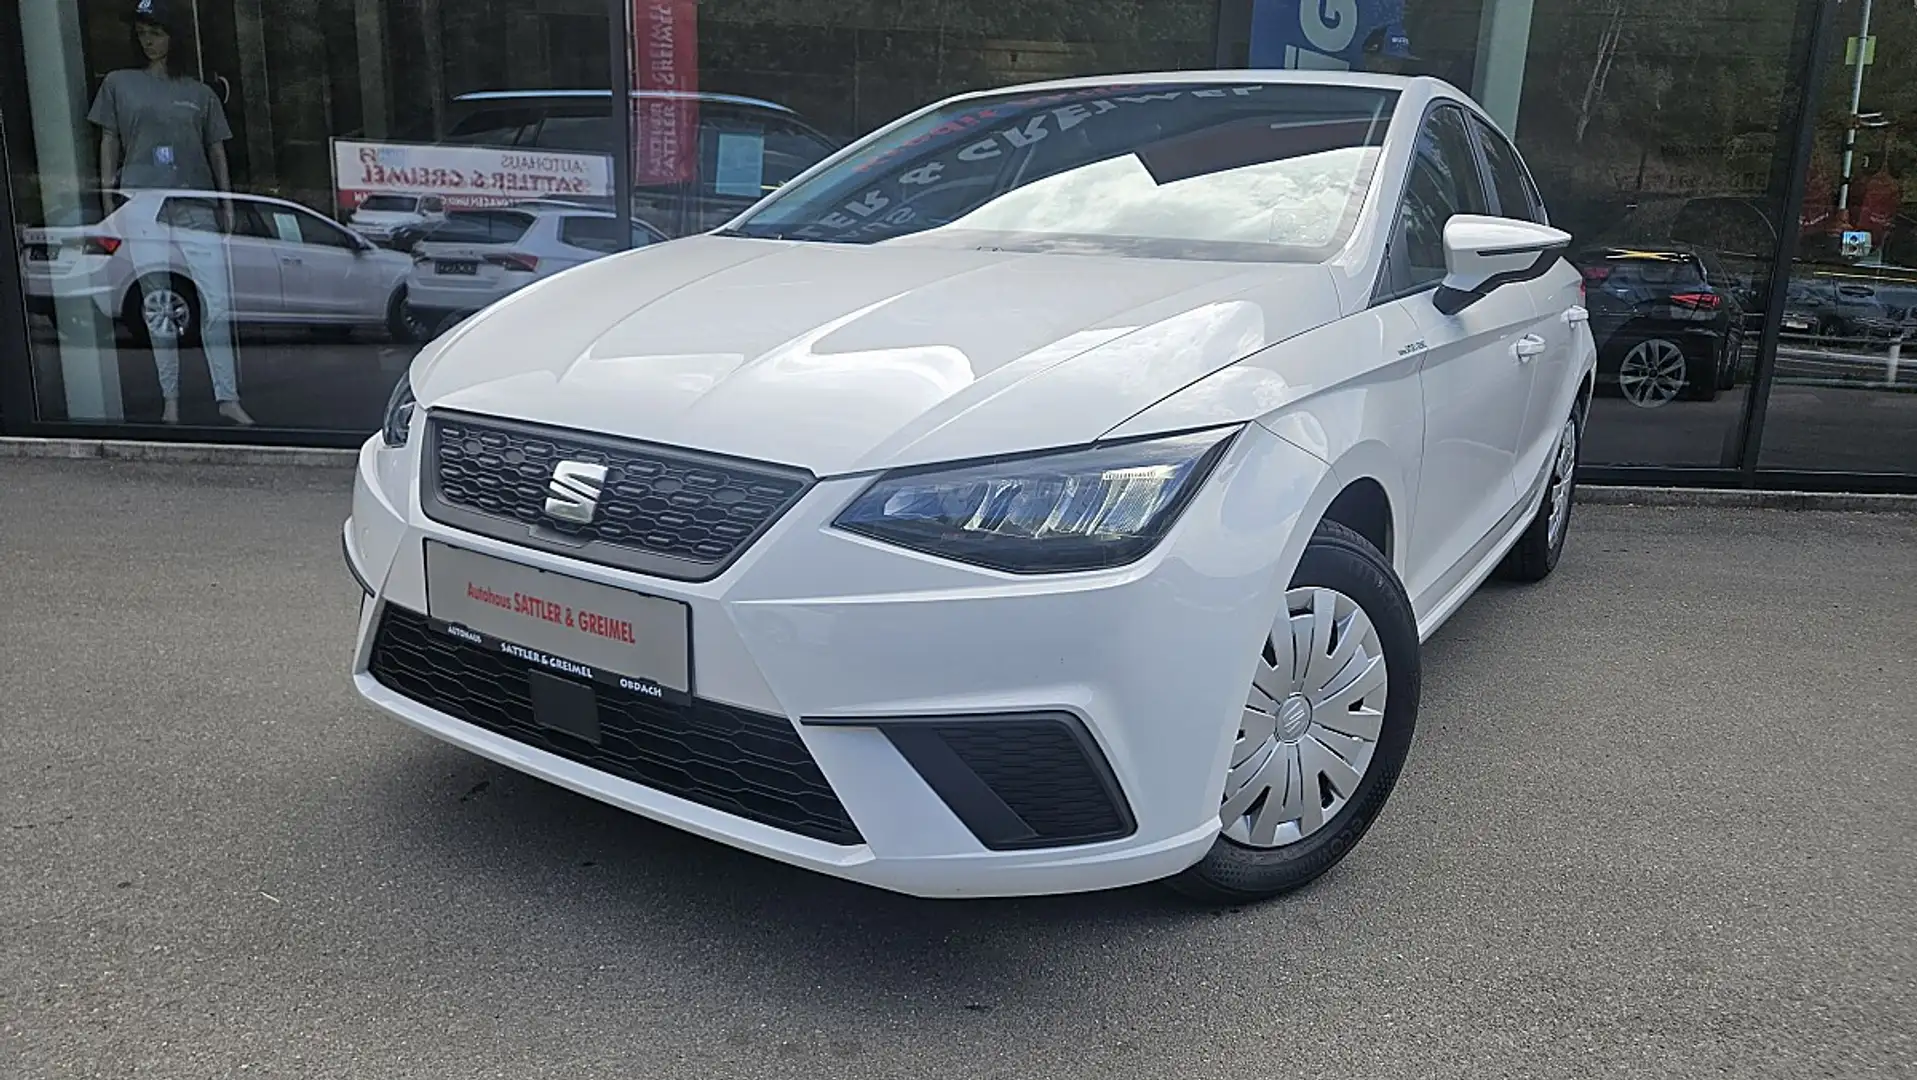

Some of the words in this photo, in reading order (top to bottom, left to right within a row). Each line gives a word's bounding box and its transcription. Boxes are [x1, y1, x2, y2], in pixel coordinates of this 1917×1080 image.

[467, 581, 512, 611] Autohaus
[513, 591, 562, 625] SATTLER
[565, 608, 574, 627] &
[578, 611, 636, 645] GREIMEL
[447, 625, 483, 644] AUTOHAUS
[500, 642, 541, 664] SATTLER
[541, 654, 549, 666] &
[549, 656, 594, 679] GREIMEL
[619, 677, 663, 698] OBDACH
